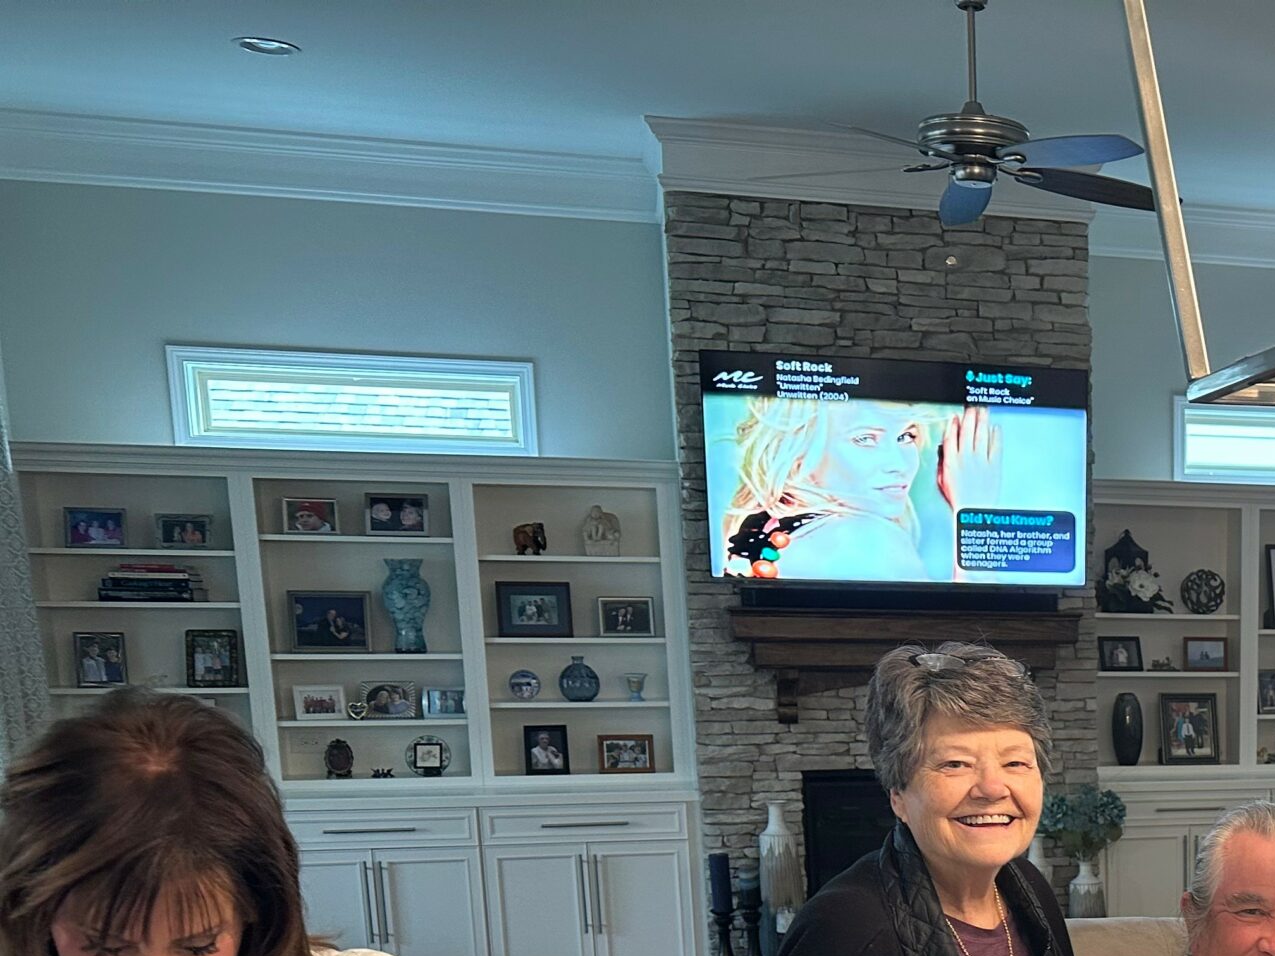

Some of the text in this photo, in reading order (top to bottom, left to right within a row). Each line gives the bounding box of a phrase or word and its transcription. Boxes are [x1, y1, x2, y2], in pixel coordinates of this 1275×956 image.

[776, 361, 833, 373] Soft Rock
[776, 374, 859, 385] Natasha Bedingfield
[975, 372, 1032, 388] Just Say:
[777, 391, 849, 402] Unwritten (2004)
[989, 388, 1010, 396] Rock
[979, 395, 1002, 403] Music
[960, 513, 1054, 526] Did You Know?
[961, 530, 1070, 540] Natasha, her brother, and
[986, 538, 1019, 546] formed
[1028, 540, 1053, 548] group
[961, 544, 988, 552] called
[1009, 546, 1052, 554] Algorithm
[960, 552, 986, 560] when
[986, 553, 1007, 561] they
